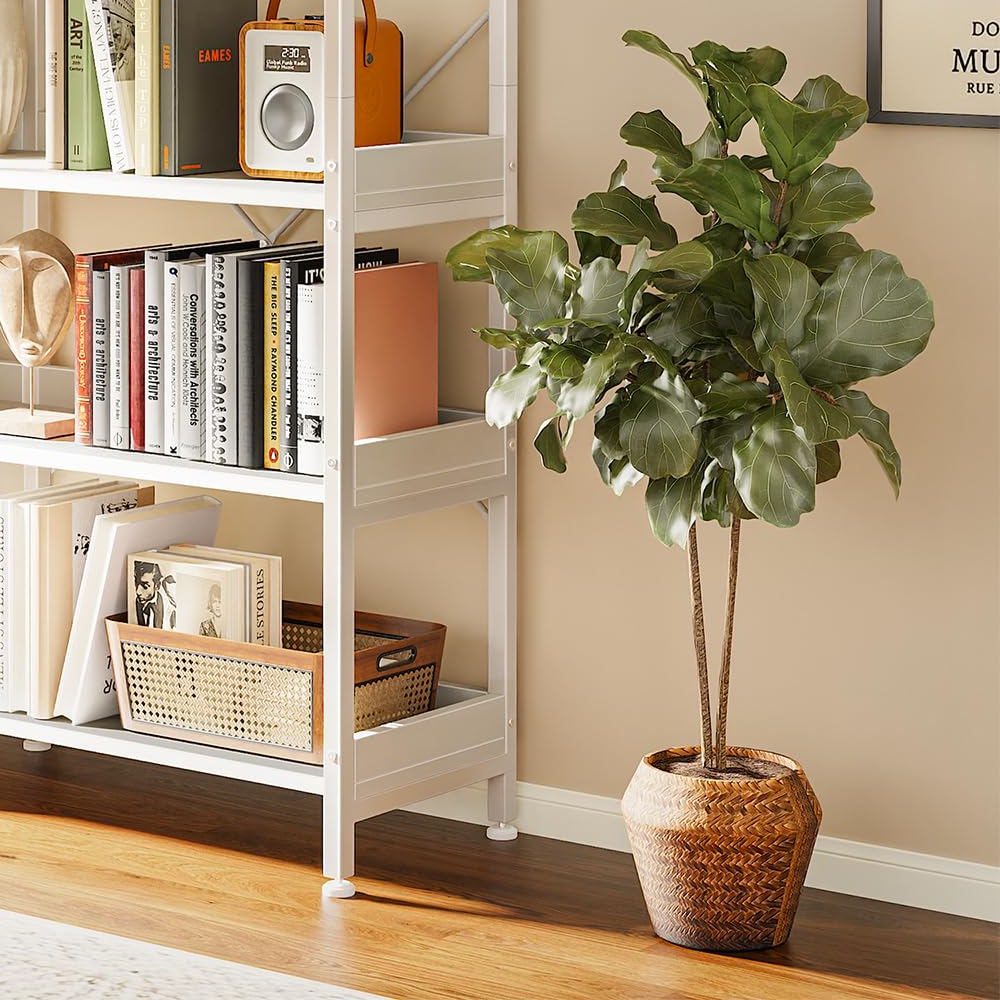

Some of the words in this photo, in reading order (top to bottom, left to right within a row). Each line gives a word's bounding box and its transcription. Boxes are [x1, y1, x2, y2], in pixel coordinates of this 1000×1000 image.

[70, 17, 83, 50] ART
[162, 45, 171, 70] EAMES
[198, 48, 233, 63] EAMES
[281, 47, 300, 58] 2:30
[966, 82, 995, 94] RUE
[110, 118, 120, 132] IS
[270, 275, 278, 292] THE
[270, 294, 278, 309] BIG
[95, 318, 107, 335] arts
[148, 304, 161, 325] arts
[189, 293, 199, 358] Conversations
[270, 312, 278, 337] SLEEP
[95, 349, 108, 402] architecture
[148, 340, 162, 401] architecture
[189, 360, 199, 379] with
[270, 347, 278, 393] RAYMOND
[189, 381, 199, 427] Architects
[270, 395, 278, 441] CHANDLER
[256, 568, 264, 628] STORIES
